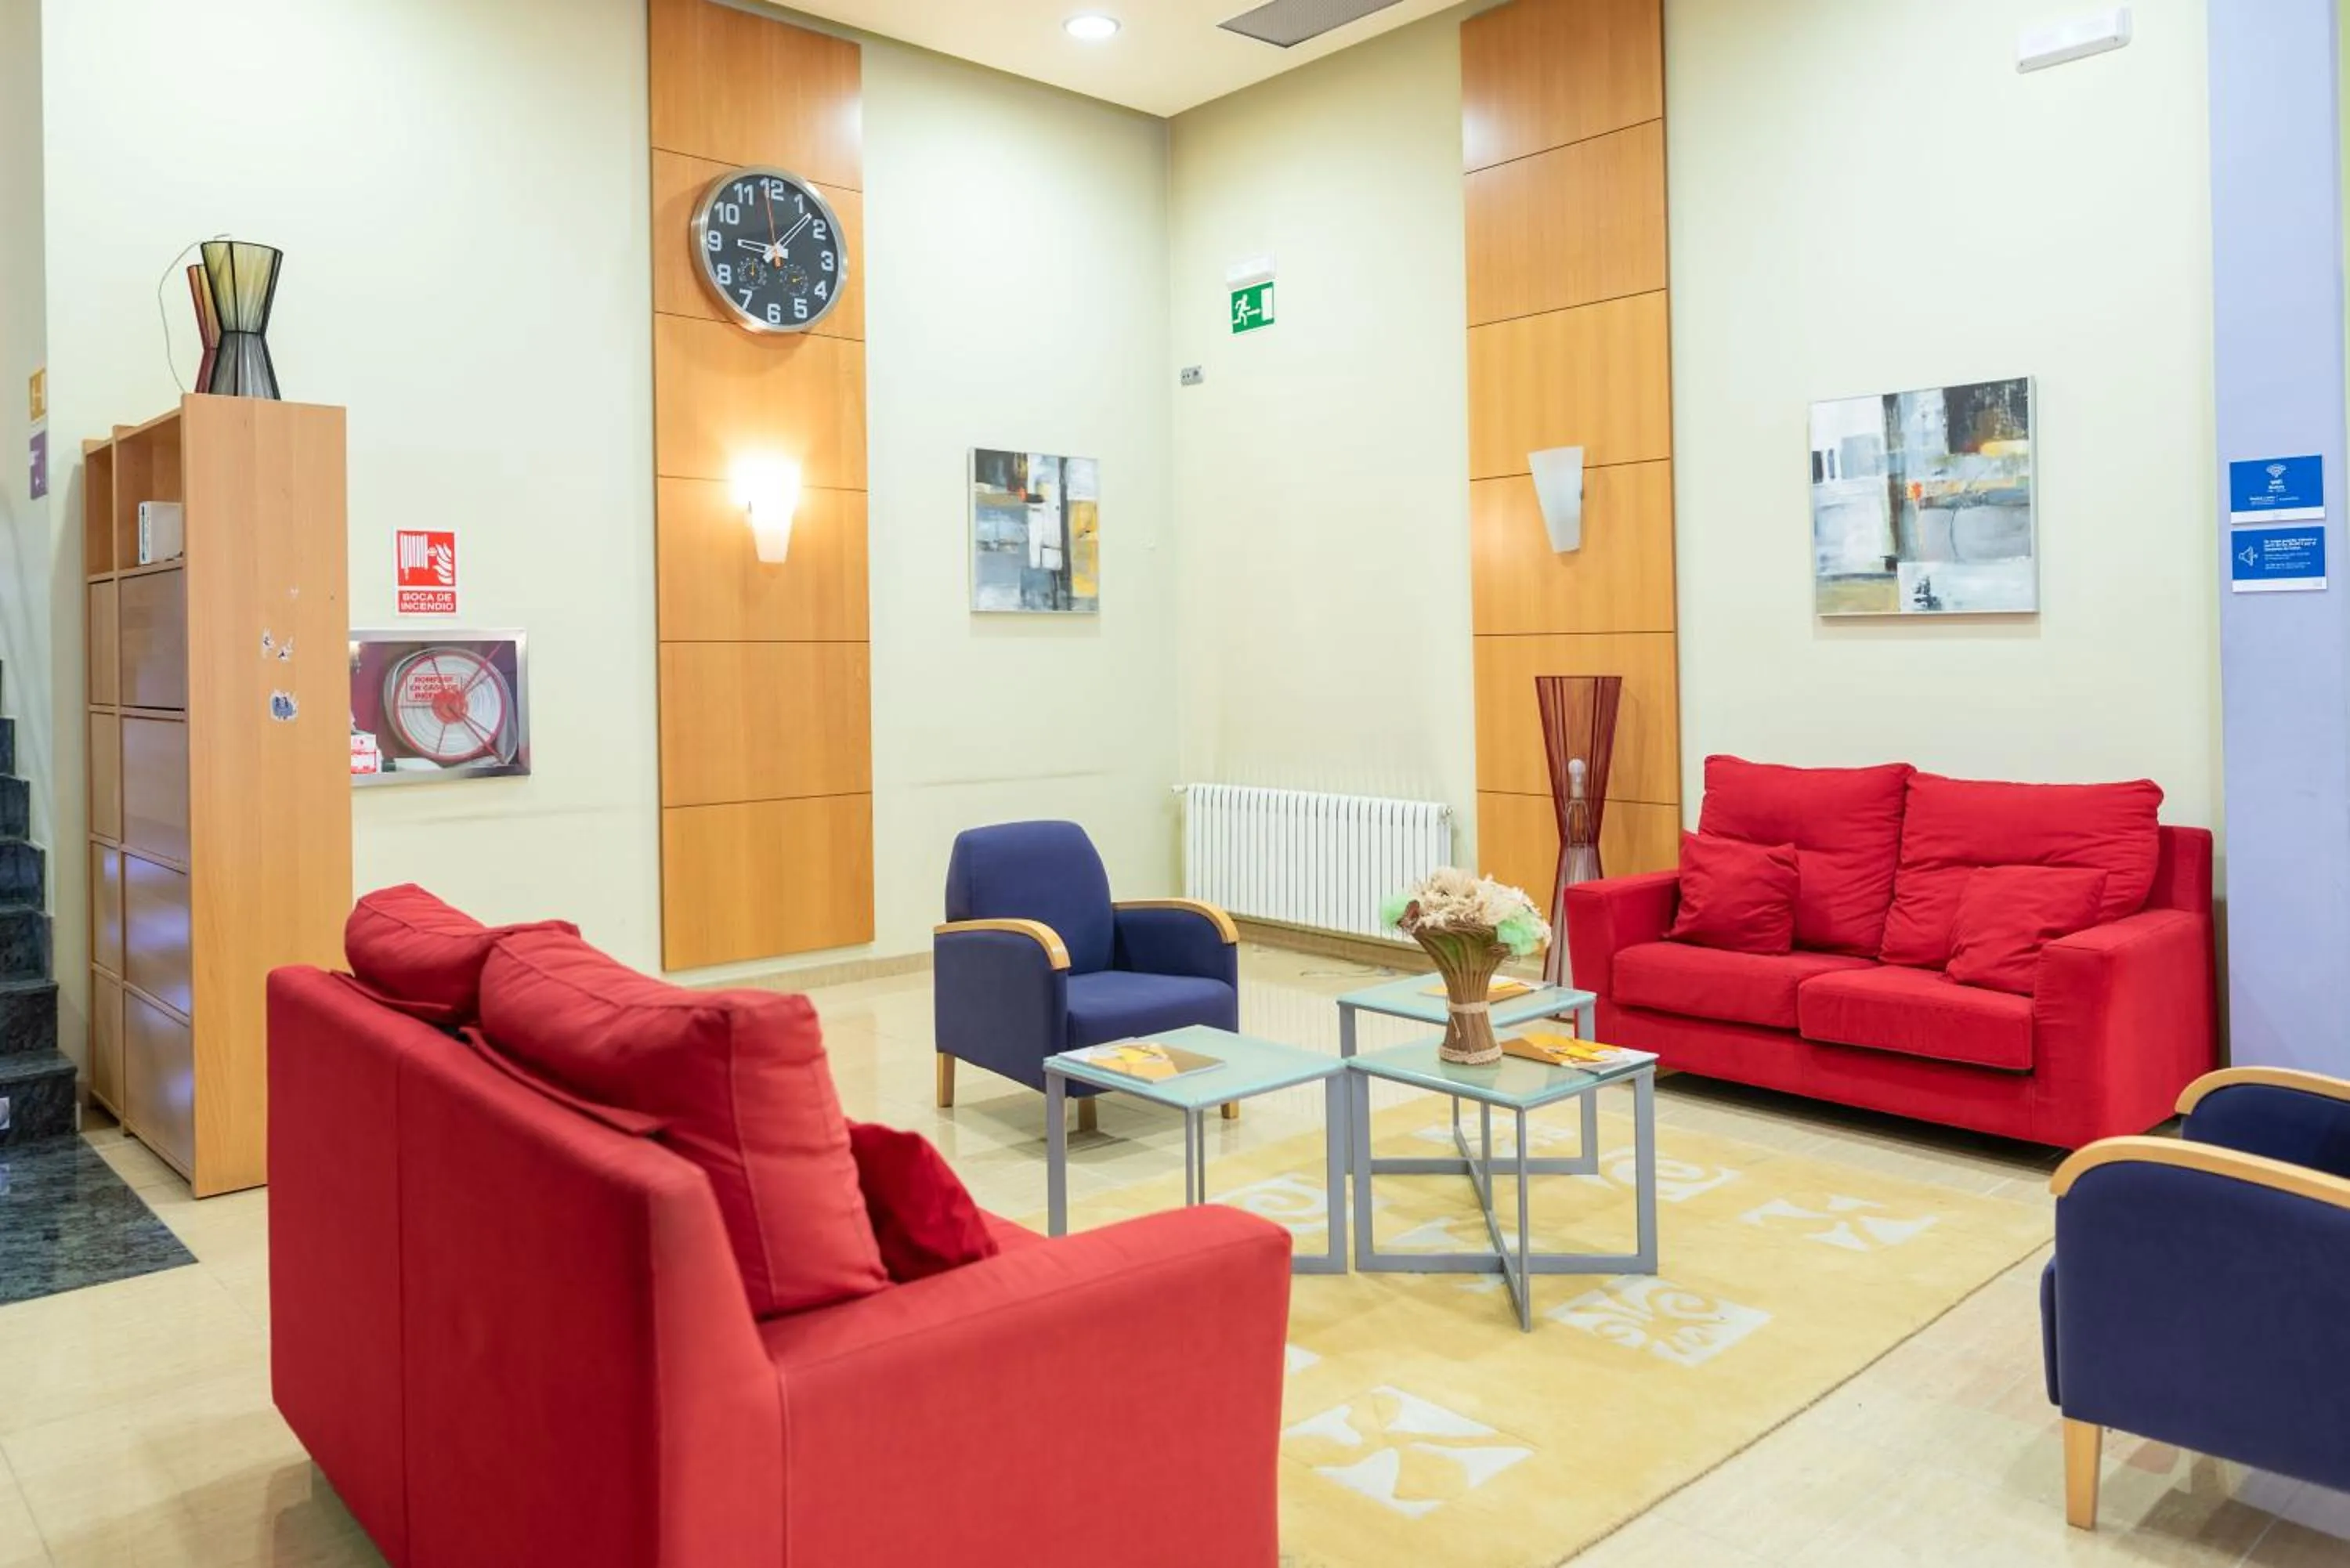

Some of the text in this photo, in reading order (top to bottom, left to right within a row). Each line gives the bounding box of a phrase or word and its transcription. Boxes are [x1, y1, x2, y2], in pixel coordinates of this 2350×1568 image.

[733, 183, 754, 206] 11
[759, 177, 784, 201] 12
[714, 202, 740, 225] 10
[794, 194, 804, 214] 1
[812, 219, 826, 240] 2
[707, 230, 722, 251] 9
[821, 251, 834, 271] 3
[717, 264, 732, 285] 8
[739, 289, 753, 309] 7
[814, 281, 828, 300] 4
[767, 304, 781, 323] 6
[794, 298, 808, 318] 5
[402, 592, 452, 602] BOCA DE
